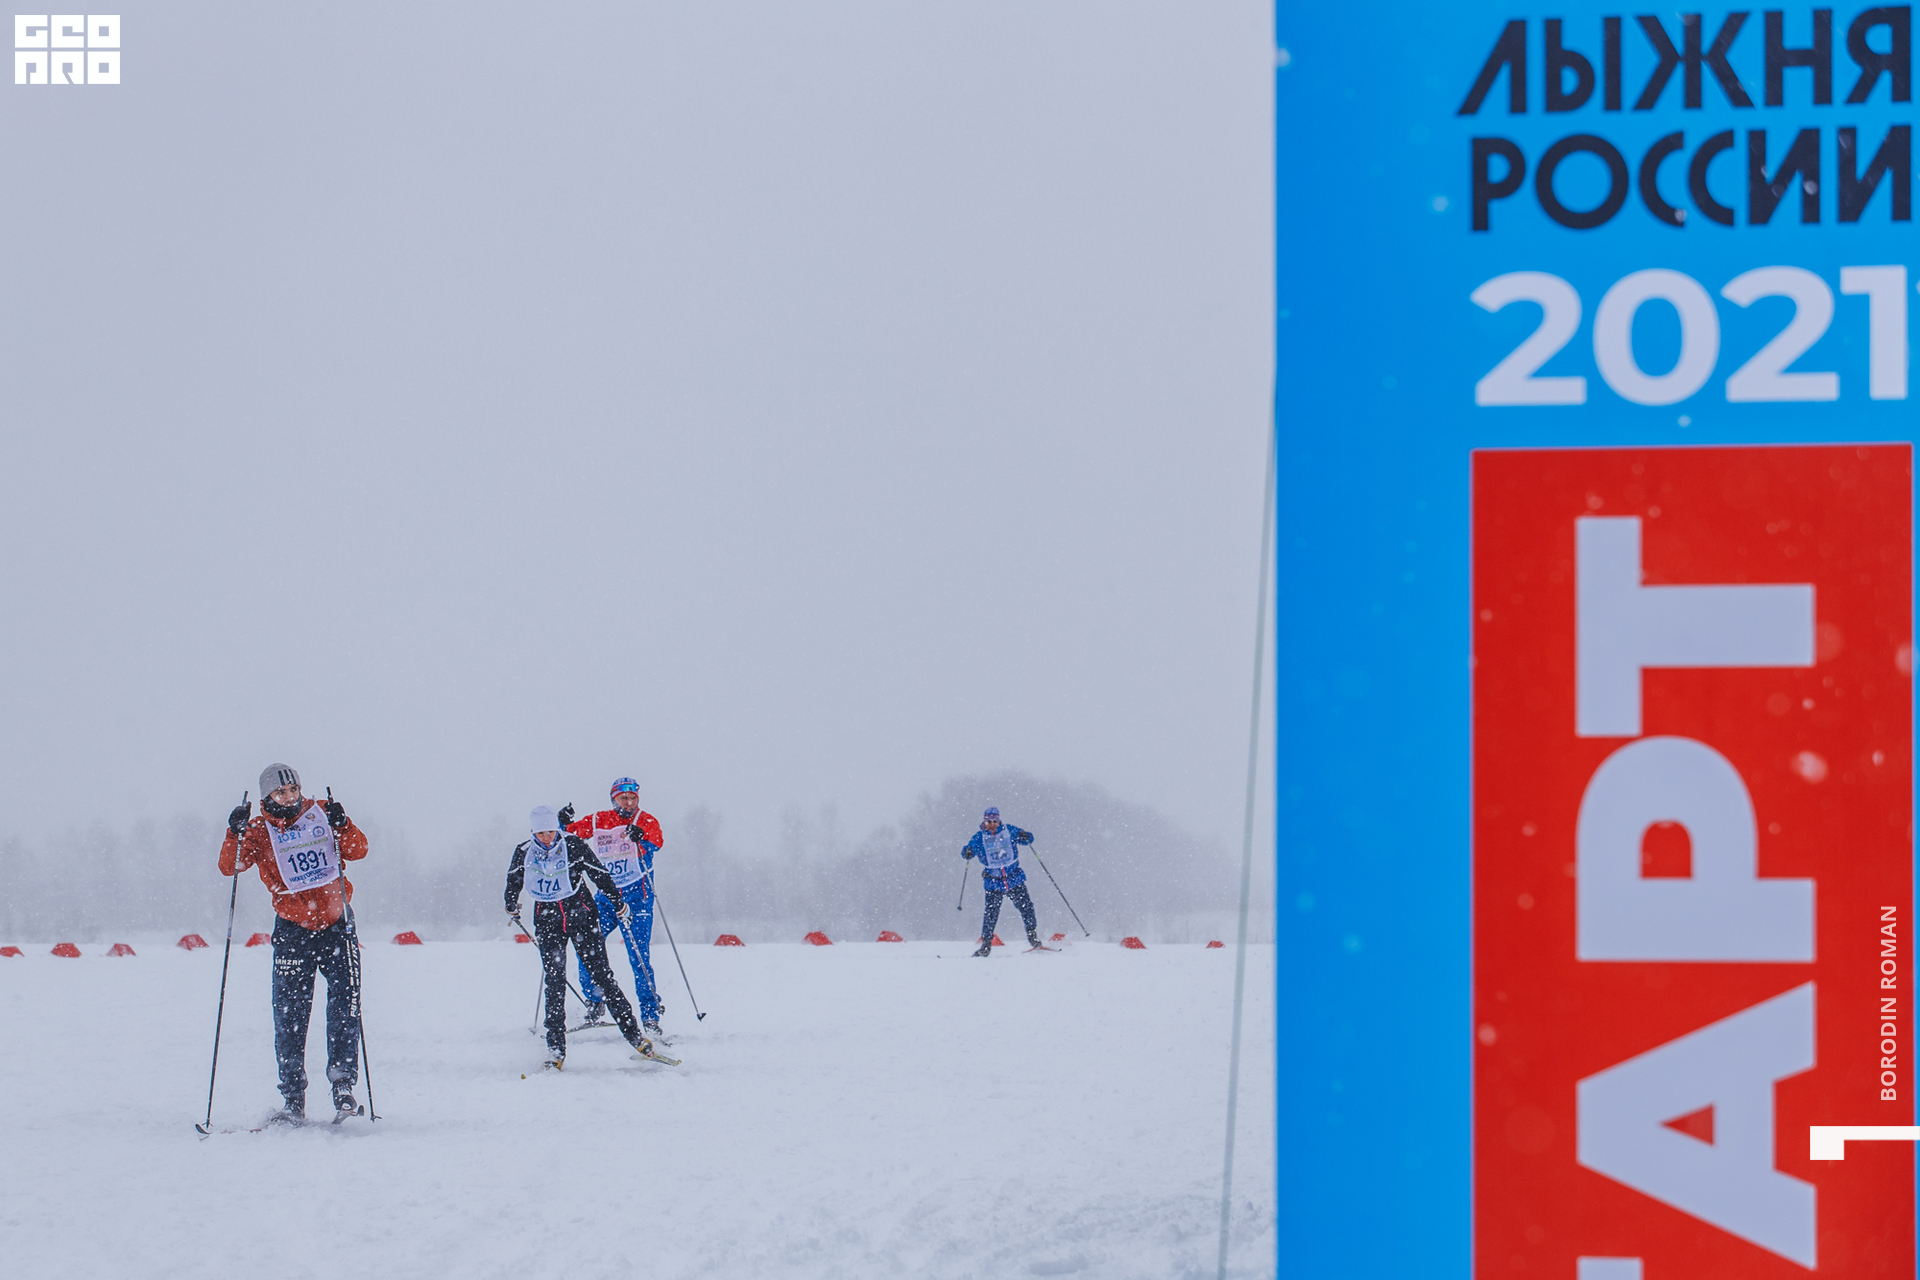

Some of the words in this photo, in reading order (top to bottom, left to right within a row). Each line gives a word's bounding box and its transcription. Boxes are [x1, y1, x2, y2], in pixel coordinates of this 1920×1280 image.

[1457, 5, 1912, 116] ЛЫЖНЯ
[1471, 124, 1912, 232] РОССИИ
[1470, 265, 1909, 406] 2021
[288, 848, 328, 873] 1891
[537, 878, 562, 893] 174
[603, 858, 628, 875] 257
[1575, 516, 1816, 1280] АРТ
